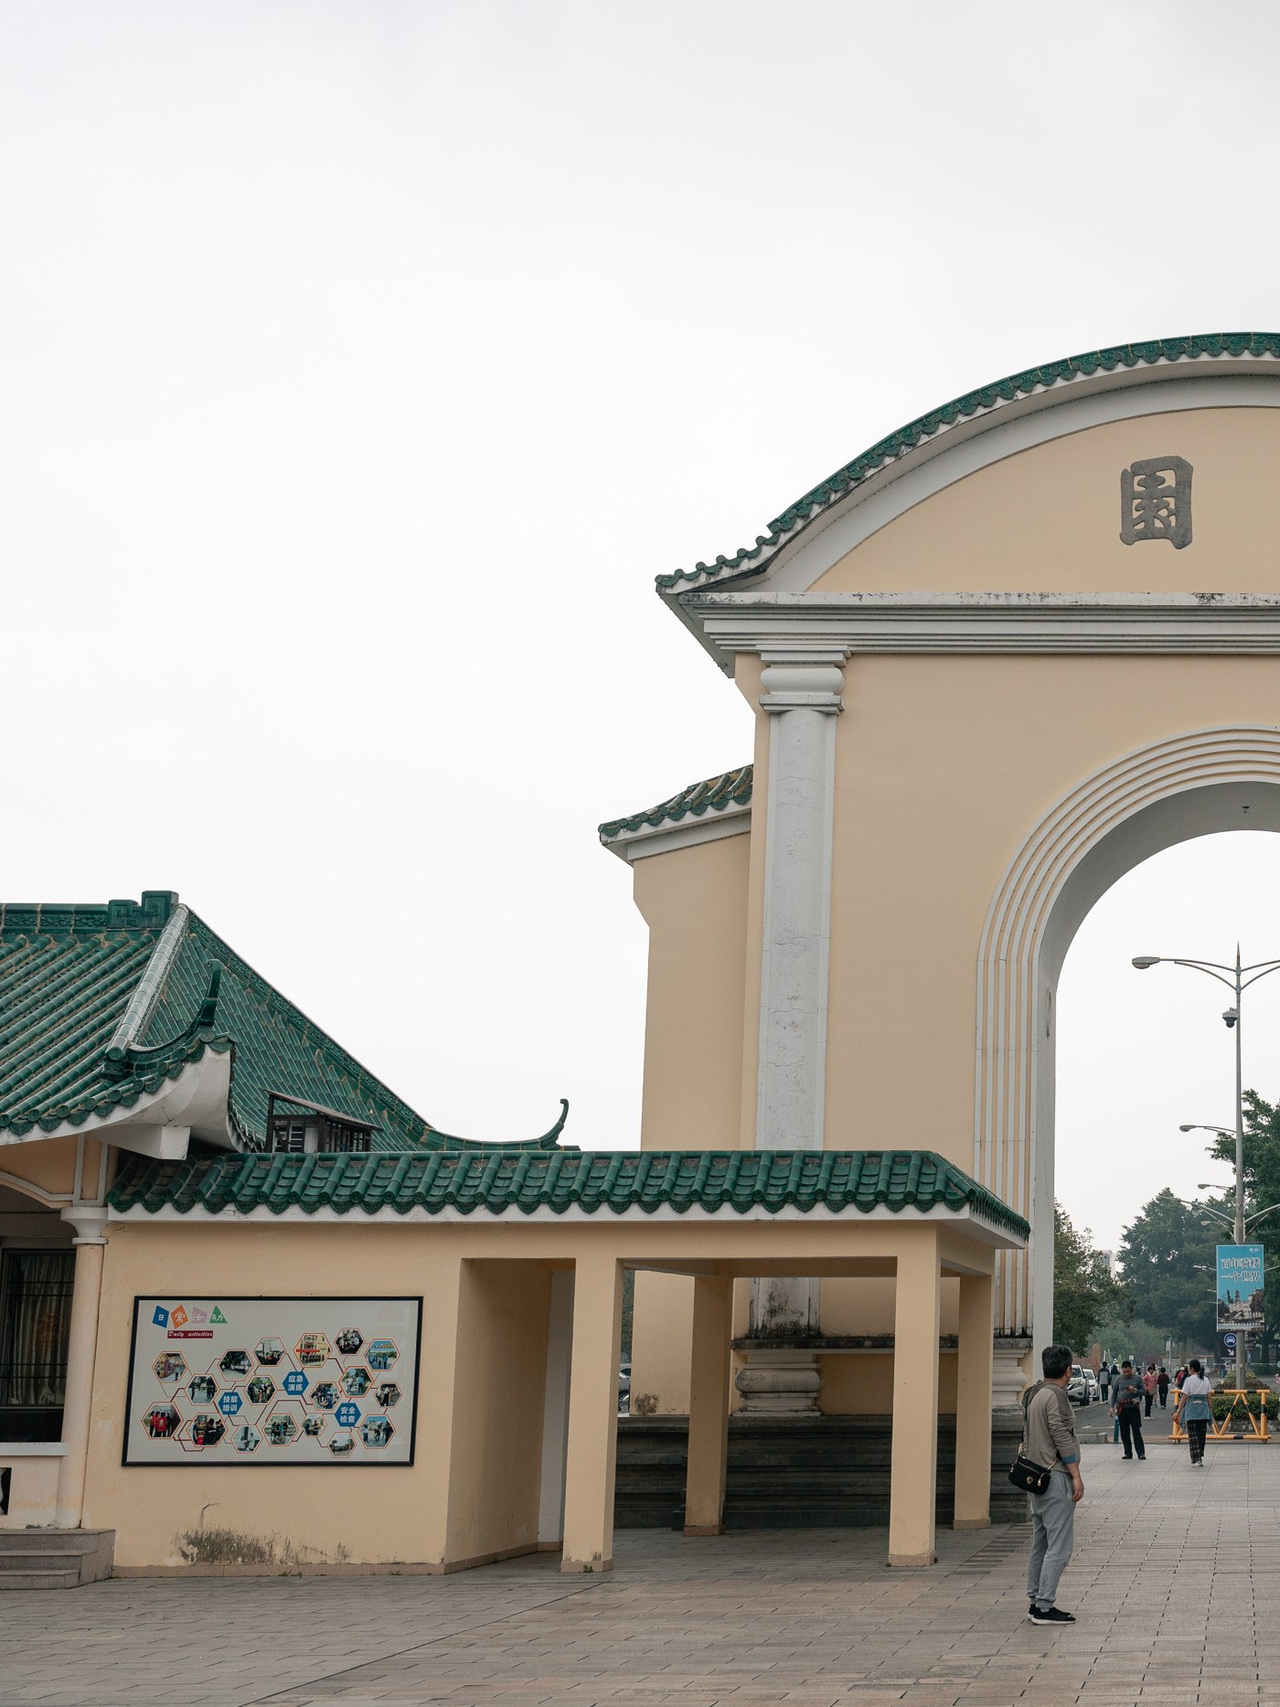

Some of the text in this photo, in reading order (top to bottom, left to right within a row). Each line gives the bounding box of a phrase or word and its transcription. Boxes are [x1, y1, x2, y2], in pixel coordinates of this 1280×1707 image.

[1221, 1271, 1261, 1283] 一个世界
[223, 1395, 238, 1403] 技能
[340, 1406, 356, 1415] 安全
[340, 1415, 355, 1423] 检查
